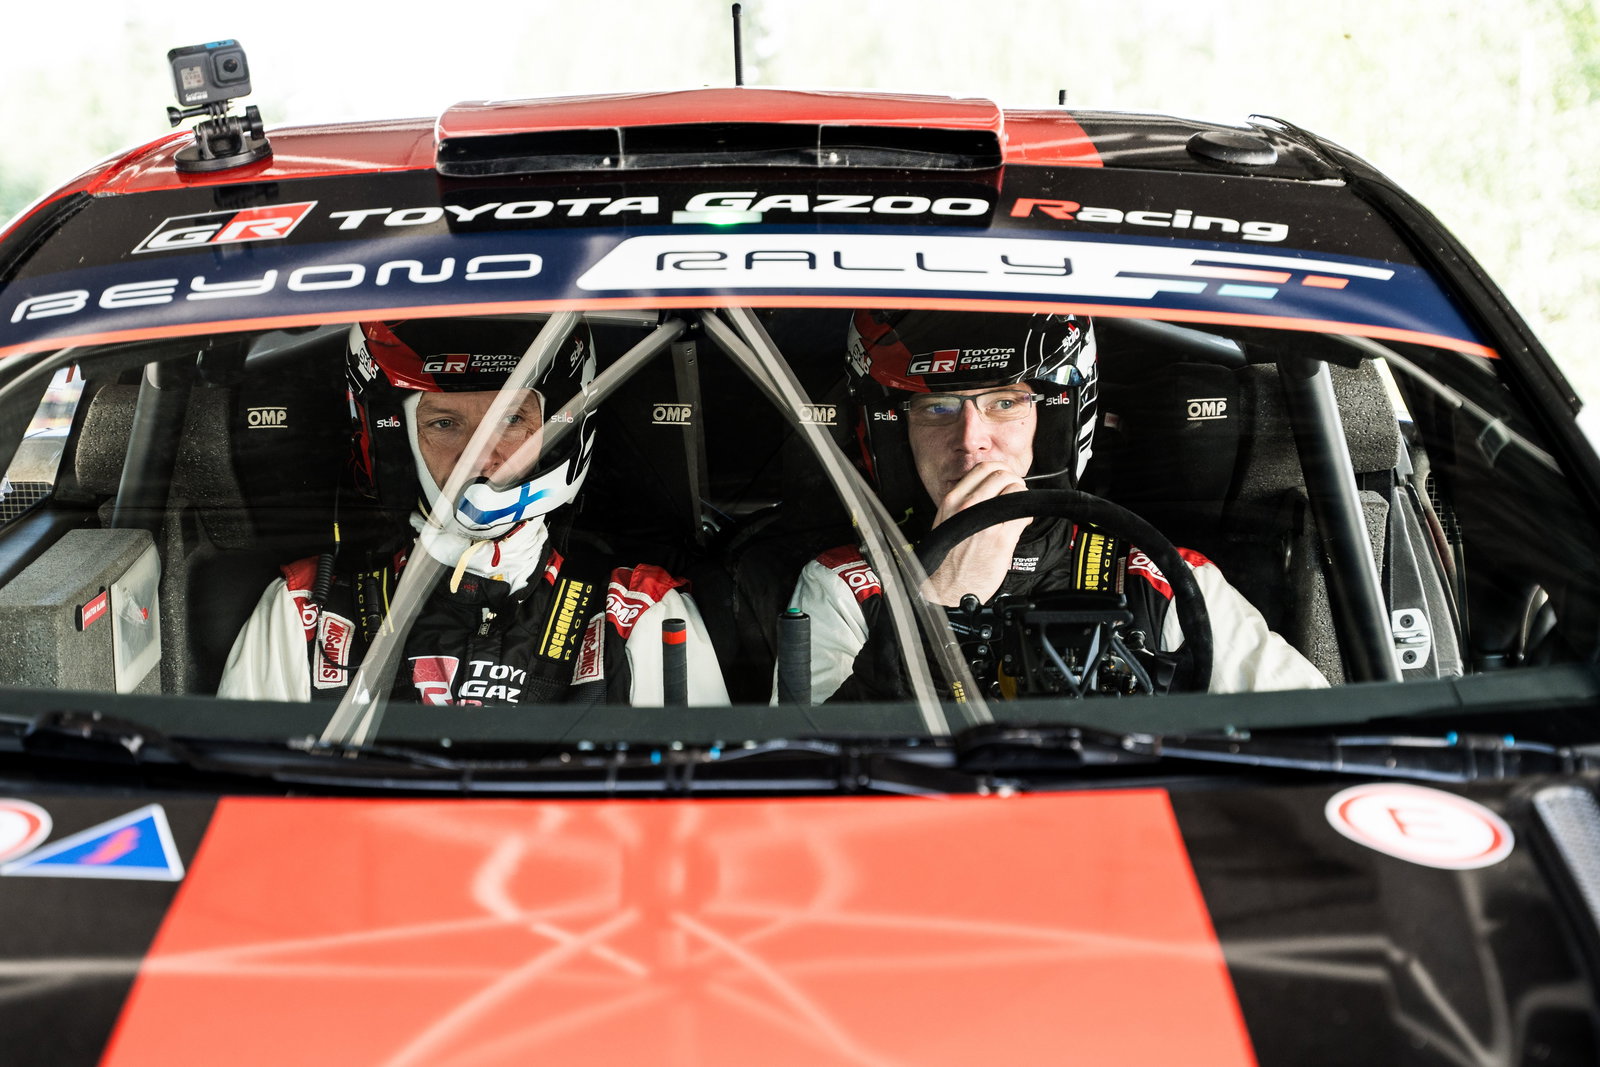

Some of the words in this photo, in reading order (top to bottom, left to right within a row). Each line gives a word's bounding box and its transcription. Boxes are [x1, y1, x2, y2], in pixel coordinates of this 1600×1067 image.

[147, 216, 293, 248] GR
[329, 196, 659, 230] TOYOTA
[684, 191, 990, 216] GAZOO
[1010, 197, 1290, 243] Racing
[10, 253, 543, 323] BEYOND
[656, 250, 1073, 277] RALLY
[960, 354, 1010, 364] GAZOO
[962, 347, 1016, 357] TOYOTA
[424, 361, 465, 372] GR
[910, 360, 955, 373] GR
[959, 361, 1009, 370] Racing
[247, 410, 287, 426] OMP
[652, 406, 692, 422] OMP
[799, 407, 837, 422] OMP
[1187, 401, 1227, 418] OMP
[1132, 555, 1165, 578] OM
[849, 571, 880, 588] OM
[547, 580, 584, 660] SCHROTH
[564, 585, 593, 660] RACING
[322, 621, 346, 680] SIMPSON
[580, 624, 597, 675] SIMPSON
[415, 681, 453, 706] R
